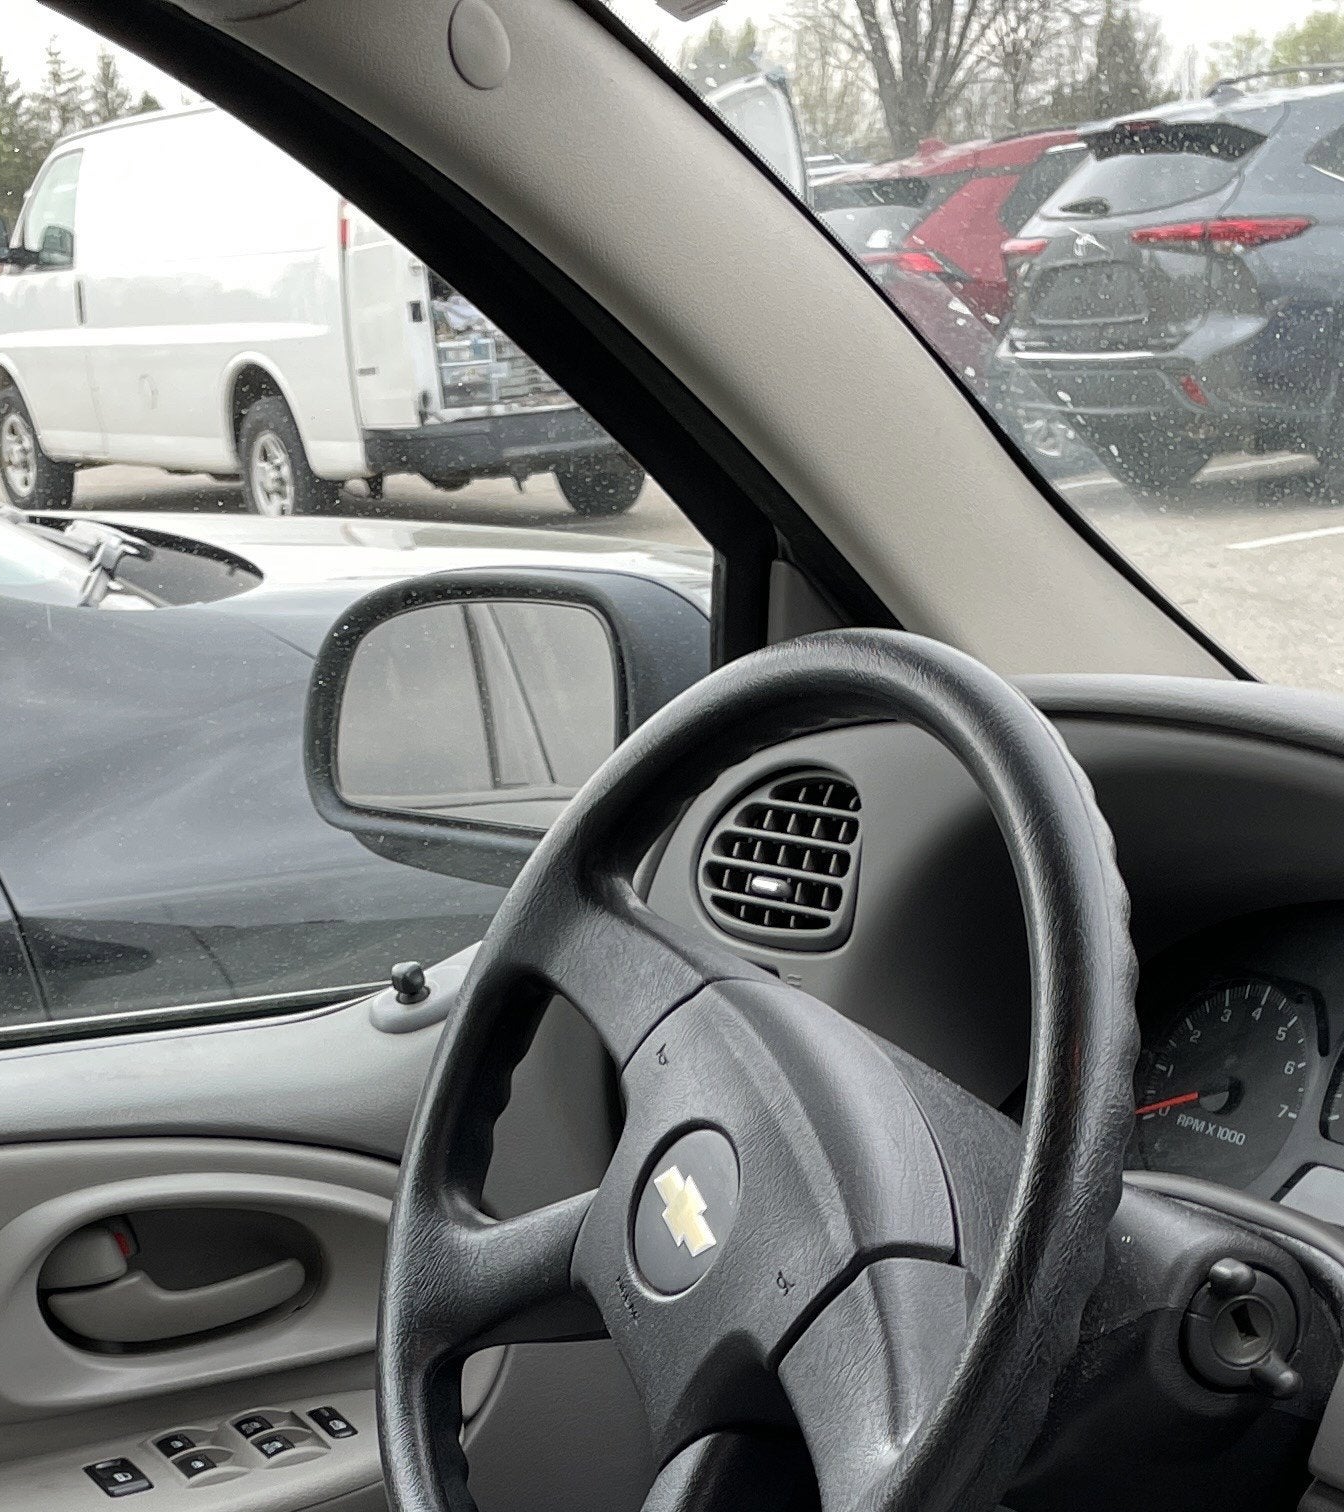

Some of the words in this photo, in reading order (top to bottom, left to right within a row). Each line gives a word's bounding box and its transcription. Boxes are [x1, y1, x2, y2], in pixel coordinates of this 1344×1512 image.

[1220, 1008, 1232, 1023] 3
[1251, 1007, 1263, 1021] 4
[1189, 1029, 1202, 1044] 2
[1275, 1026, 1288, 1041] 5
[1284, 1060, 1296, 1075] 6
[1276, 1104, 1289, 1118] 7
[1176, 1114, 1204, 1134] RPM
[1205, 1123, 1217, 1135] X
[1217, 1126, 1246, 1146] 1000
